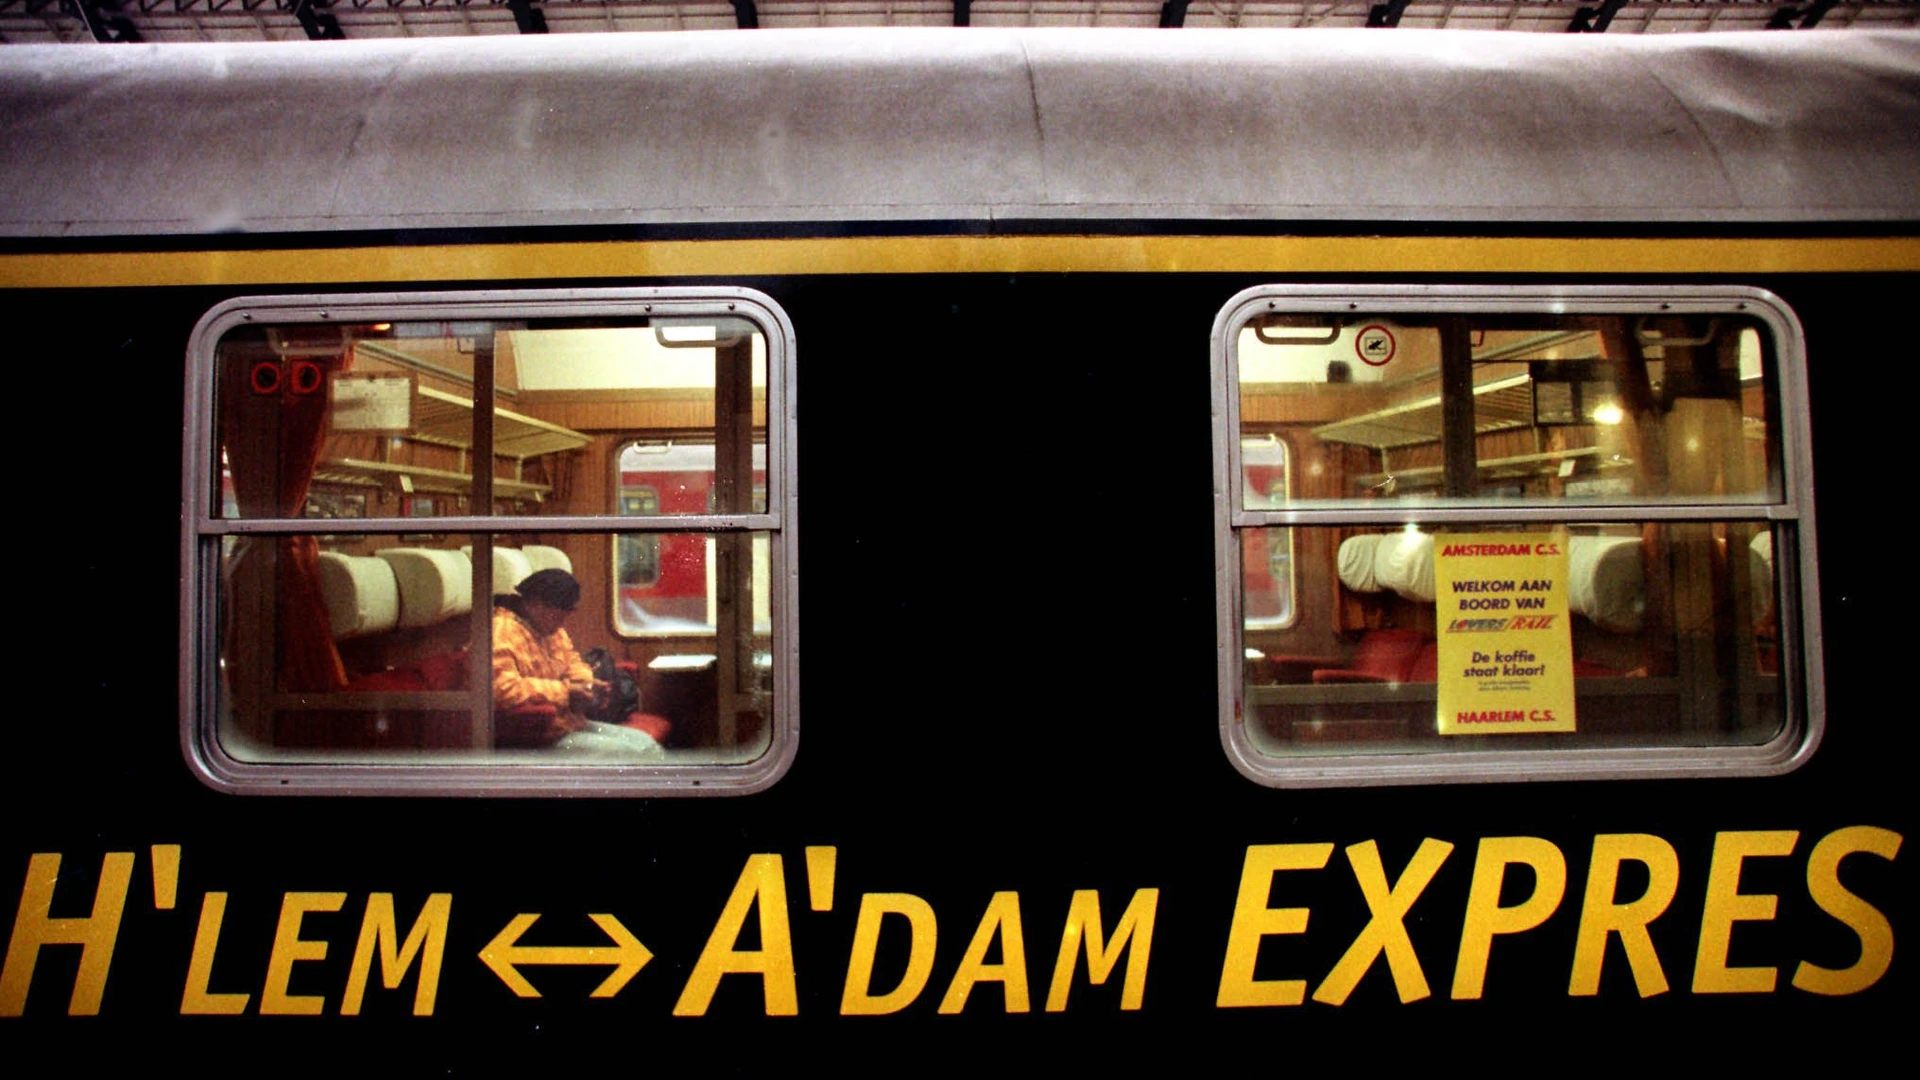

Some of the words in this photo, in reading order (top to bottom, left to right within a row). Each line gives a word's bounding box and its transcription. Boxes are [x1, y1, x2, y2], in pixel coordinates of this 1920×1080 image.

[1442, 544, 1530, 556] AMSTERDAM
[1535, 543, 1561, 555] C.S.
[1452, 580, 1515, 592] WELKOM
[1519, 580, 1552, 591] AAN
[1459, 598, 1511, 610] BOORD
[1515, 597, 1545, 609] VAN
[1472, 651, 1490, 663] De
[1495, 650, 1536, 663] koffie
[1463, 666, 1498, 677] staat
[1503, 663, 1545, 676] klaar!
[1457, 711, 1525, 724] HAARLEM
[1529, 709, 1556, 722] C.S.
[1216, 825, 1904, 1007] EXPRES
